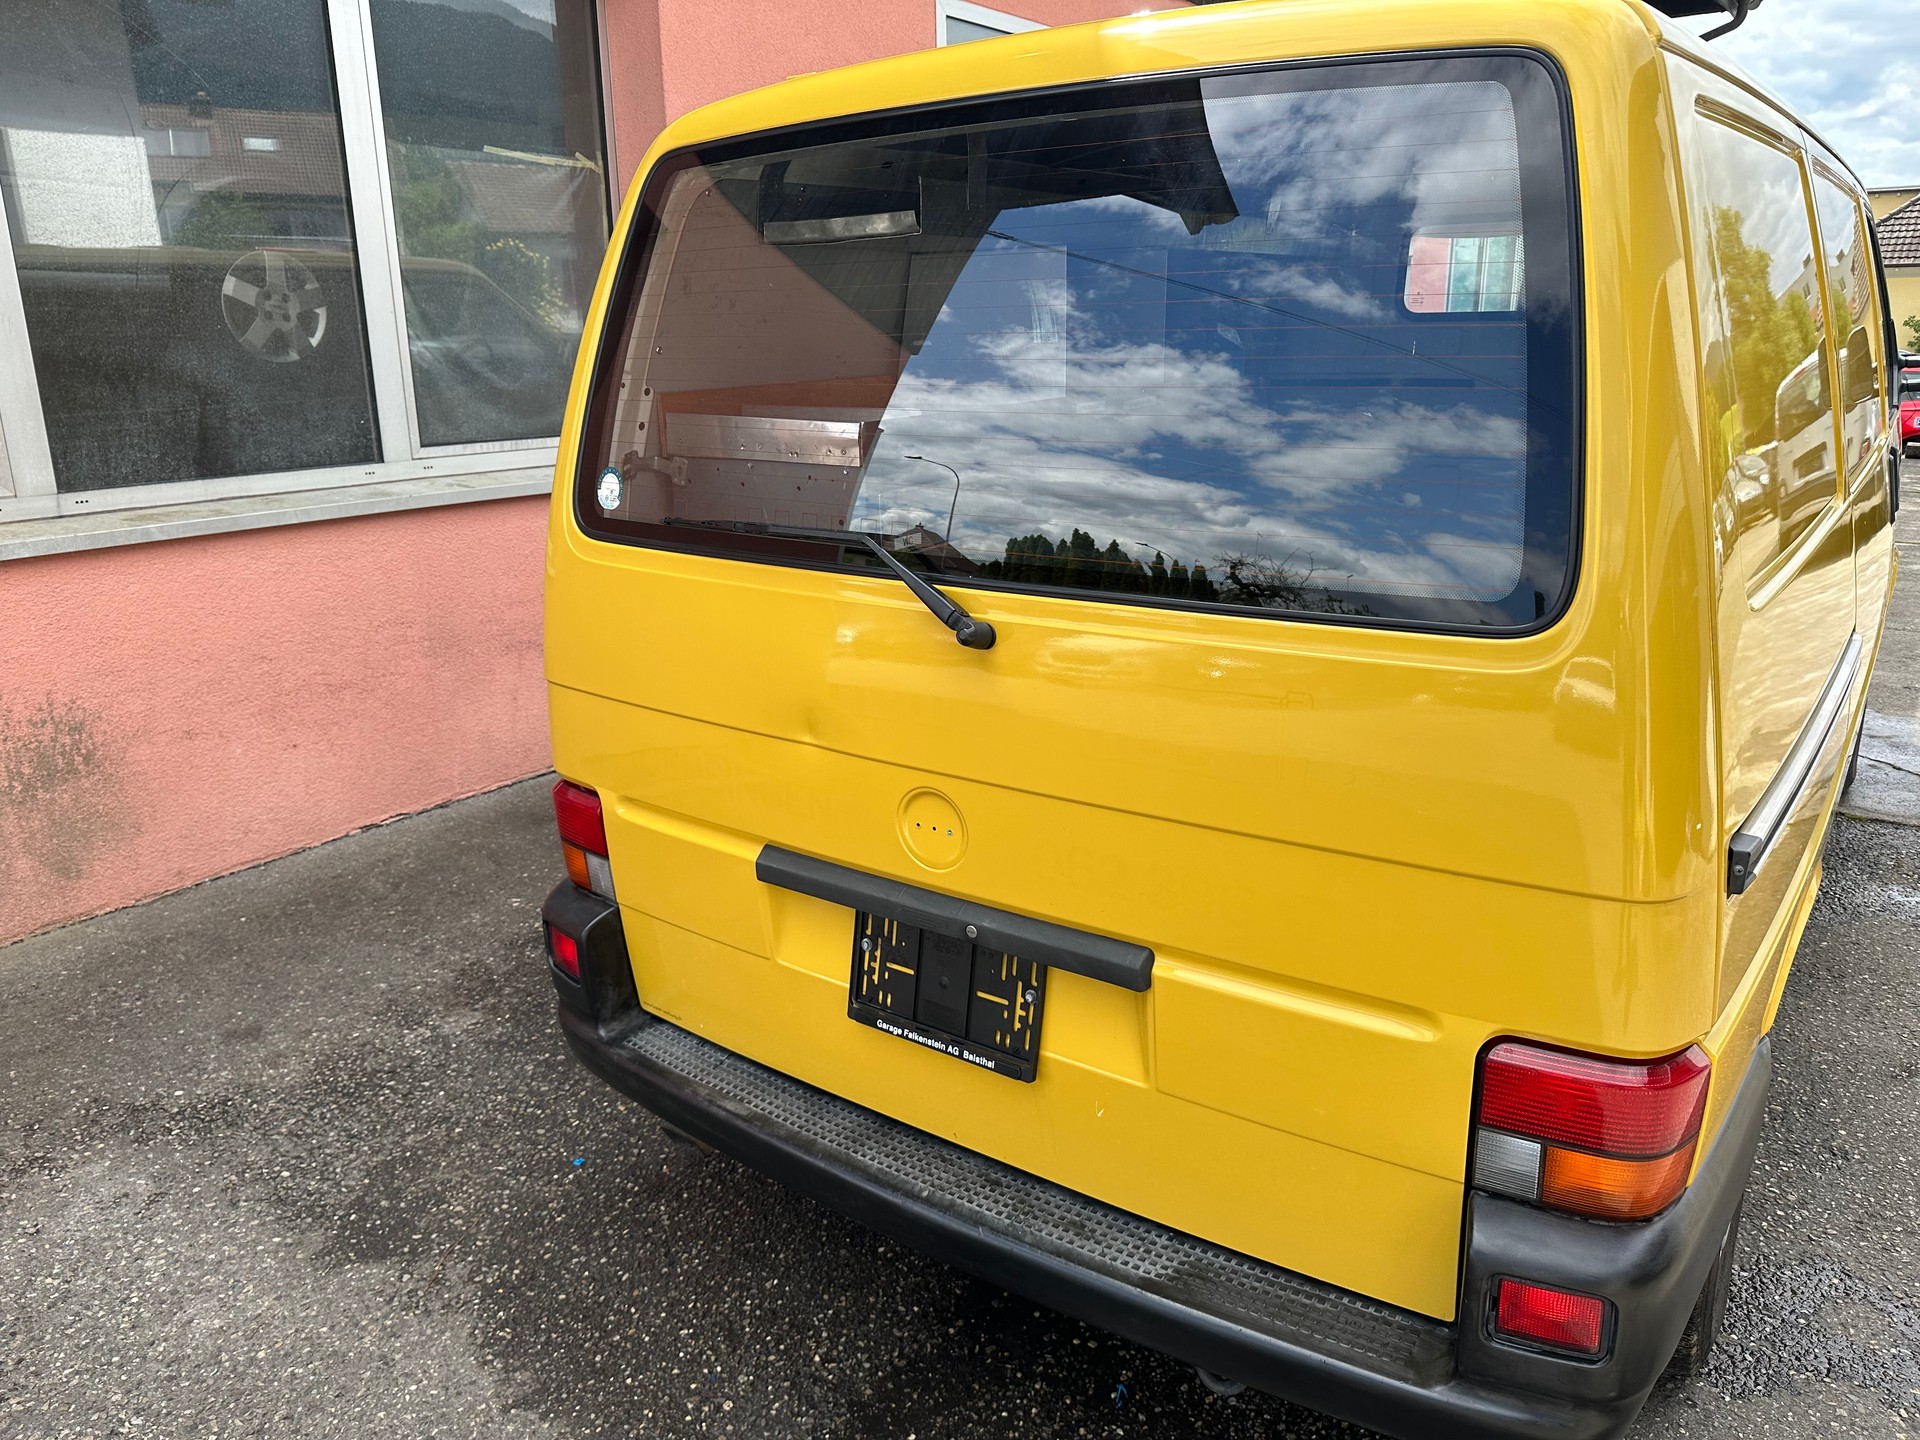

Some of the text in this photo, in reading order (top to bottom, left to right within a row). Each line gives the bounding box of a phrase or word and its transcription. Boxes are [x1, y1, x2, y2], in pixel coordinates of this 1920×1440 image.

[876, 1018, 996, 1069] Garage Falkenstein AG Balsthal
